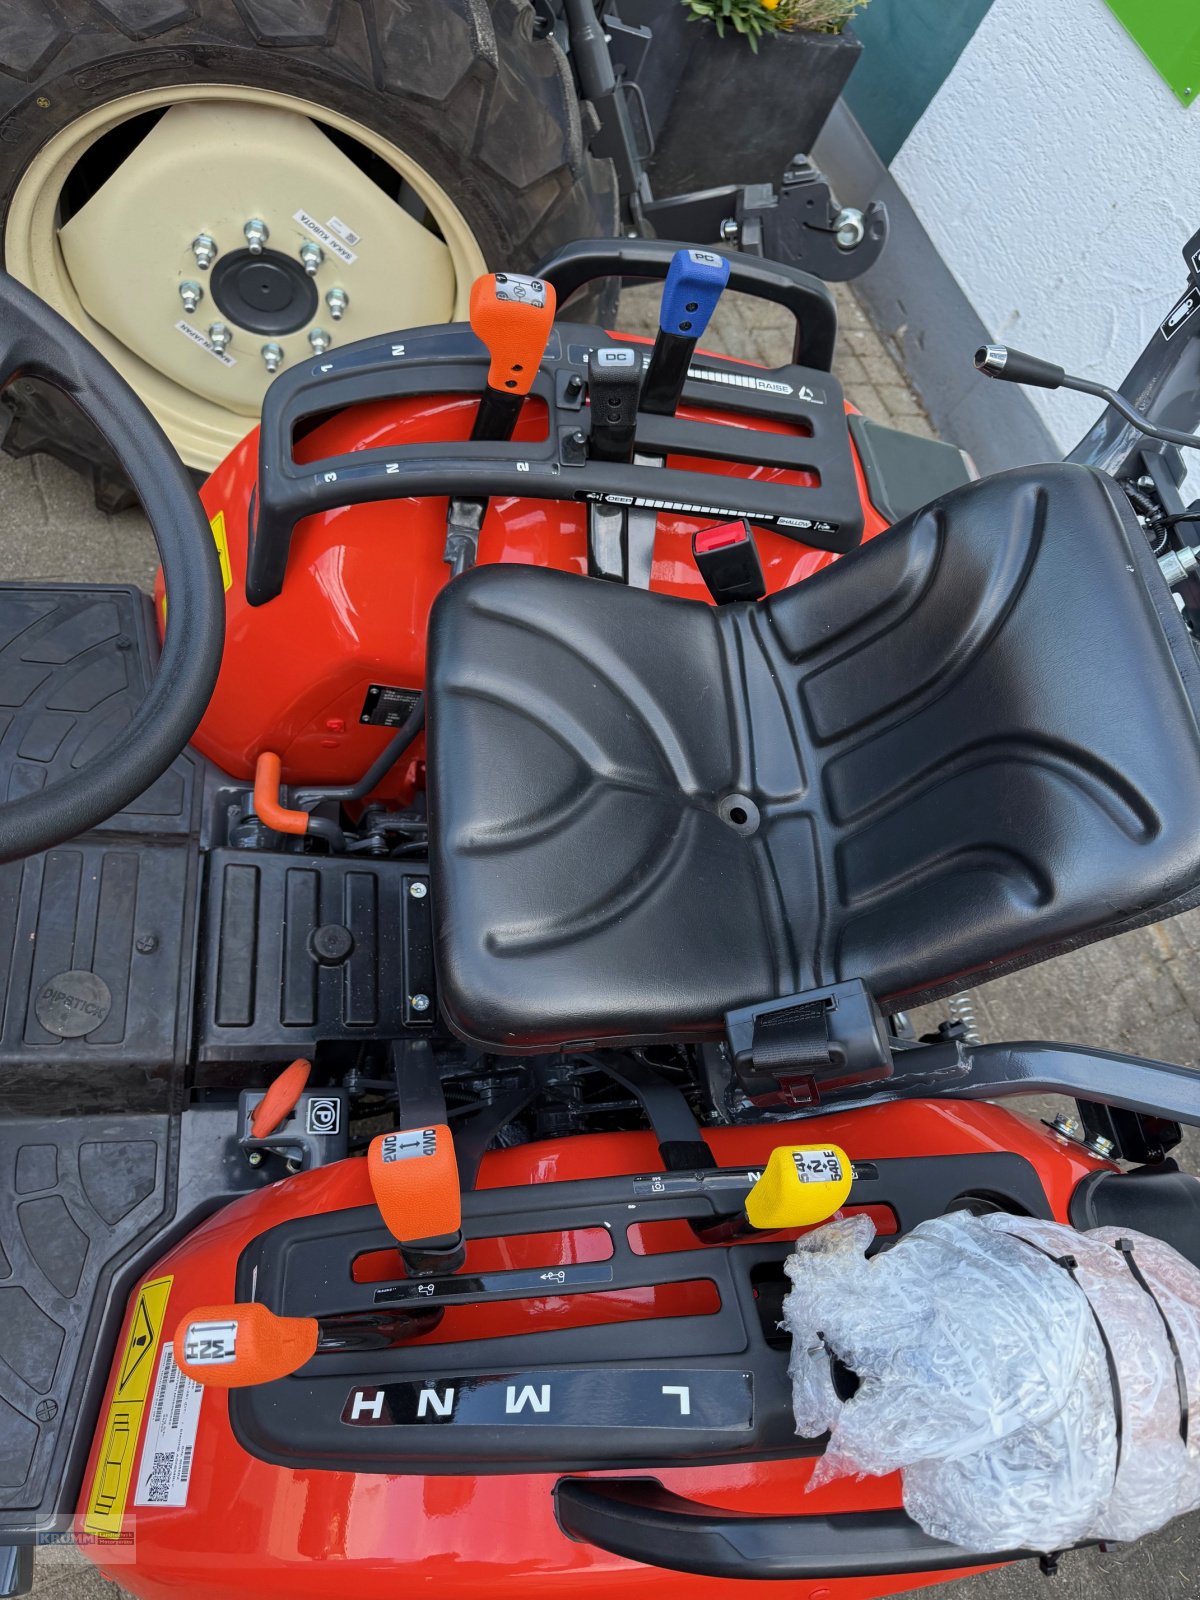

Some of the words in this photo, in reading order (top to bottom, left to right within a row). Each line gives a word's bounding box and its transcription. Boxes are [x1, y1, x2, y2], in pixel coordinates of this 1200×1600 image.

[300, 214, 330, 241] KUBOTA
[329, 240, 353, 260] SAKAI
[695, 253, 715, 262] PC
[514, 287, 526, 297] N
[532, 282, 542, 291] R
[391, 344, 406, 356] N
[605, 353, 627, 361] DC
[320, 364, 333, 373] 1
[757, 381, 790, 394] RAISE
[385, 463, 400, 474] N
[516, 462, 530, 472] 2
[324, 472, 337, 483] 3
[607, 495, 632, 503] DEEP
[778, 518, 810, 528] SHALLOW
[42, 988, 106, 1019] DIPSTICK
[383, 1135, 397, 1163] 2WD
[422, 1129, 437, 1156] 4WD
[792, 1152, 810, 1183] 540
[810, 1159, 824, 1173] N
[826, 1159, 842, 1181] 540
[747, 1171, 761, 1182] N
[186, 1342, 199, 1360] H
[199, 1340, 212, 1359] N
[211, 1340, 225, 1359] M
[350, 1391, 385, 1420] H
[416, 1388, 455, 1417] N
[505, 1384, 551, 1414] M
[661, 1385, 691, 1415] L
